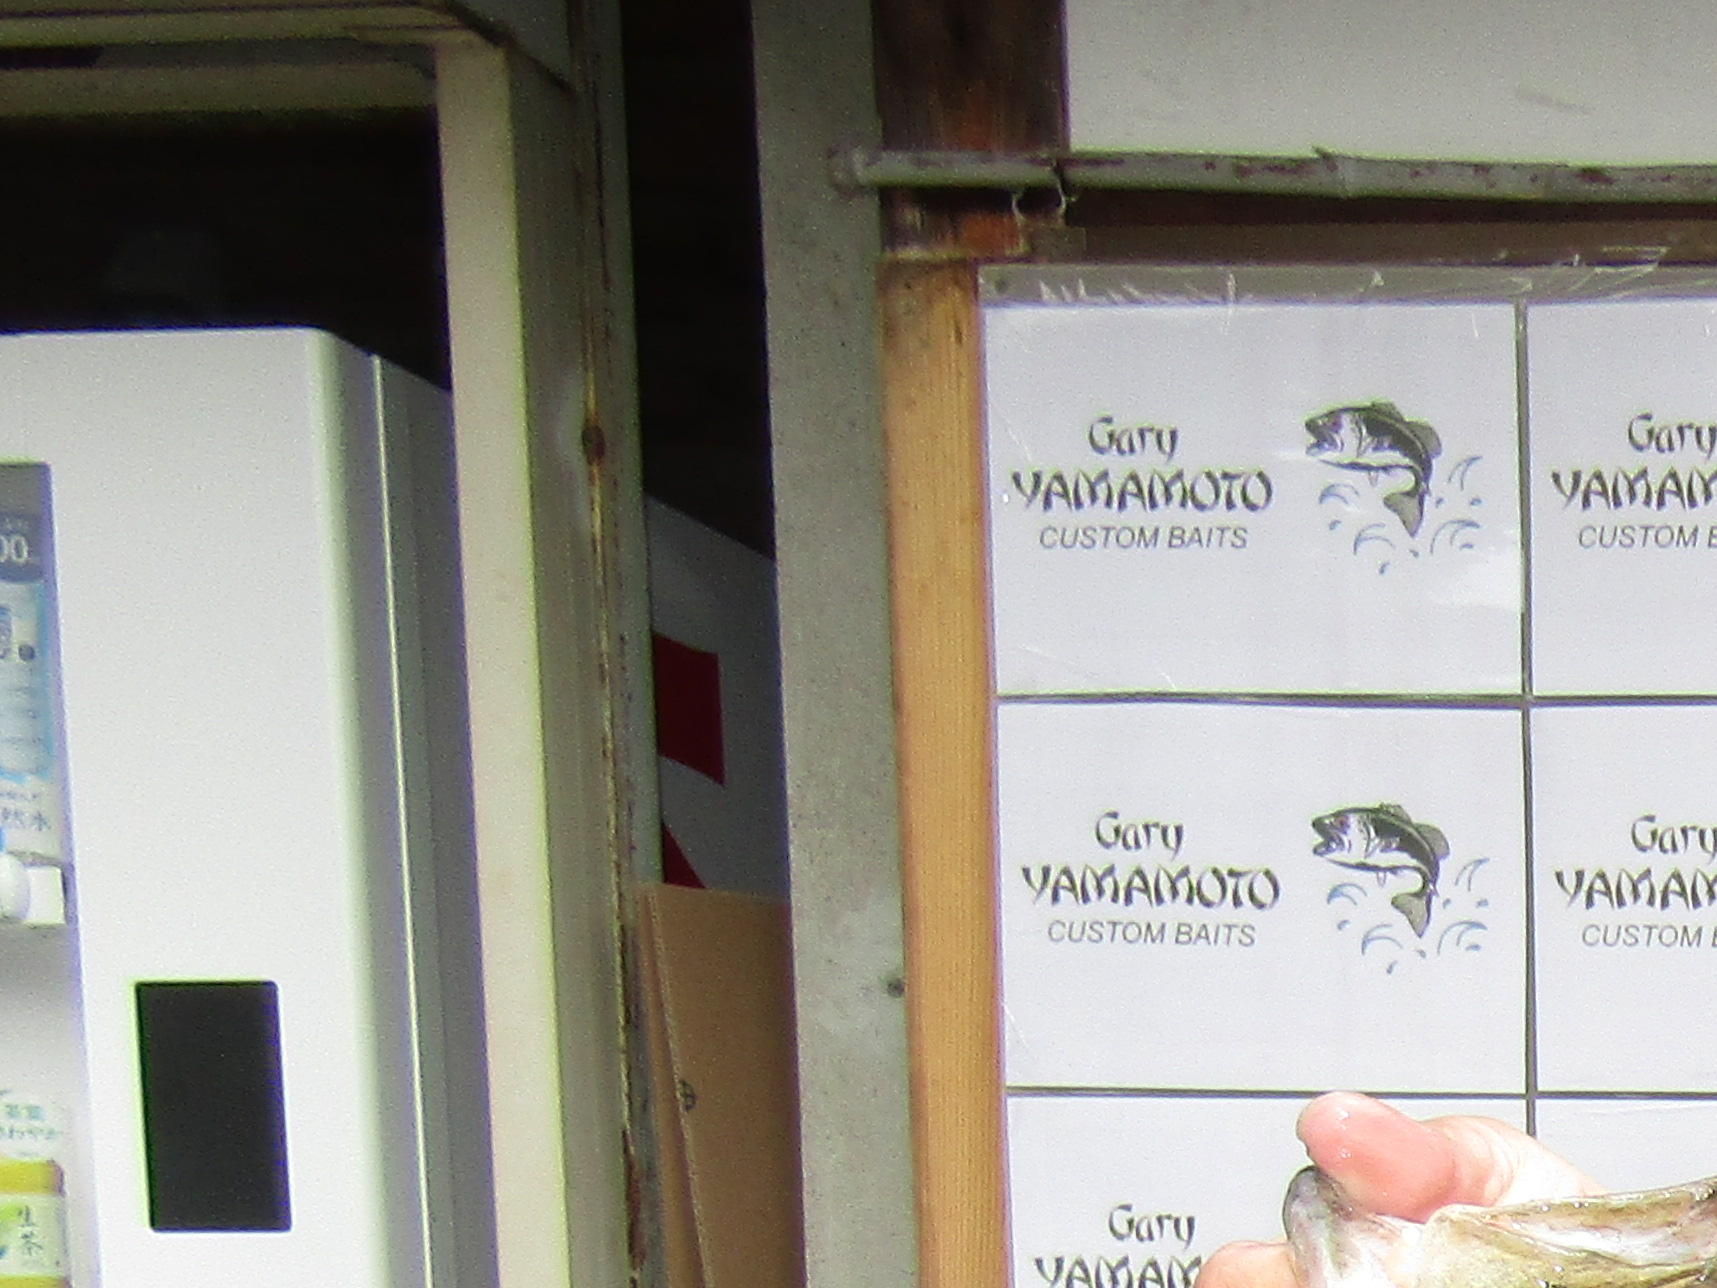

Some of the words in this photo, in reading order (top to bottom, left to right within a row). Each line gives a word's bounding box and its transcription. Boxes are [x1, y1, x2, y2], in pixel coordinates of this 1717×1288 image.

[1089, 415, 1180, 465] Gary
[1012, 469, 1274, 513] YAMAMOTO
[1040, 525, 1161, 551] CUSTOM
[1168, 525, 1249, 551] BAITS
[1578, 524, 1700, 551] CUSTOM
[1095, 810, 1185, 860] Gary
[1022, 864, 1281, 912] YAMAMOTO
[1048, 919, 1168, 949] CUSTOM
[1175, 919, 1257, 949] BAITS
[1582, 923, 1704, 951] CUSTOM
[1108, 1203, 1196, 1251] Gary
